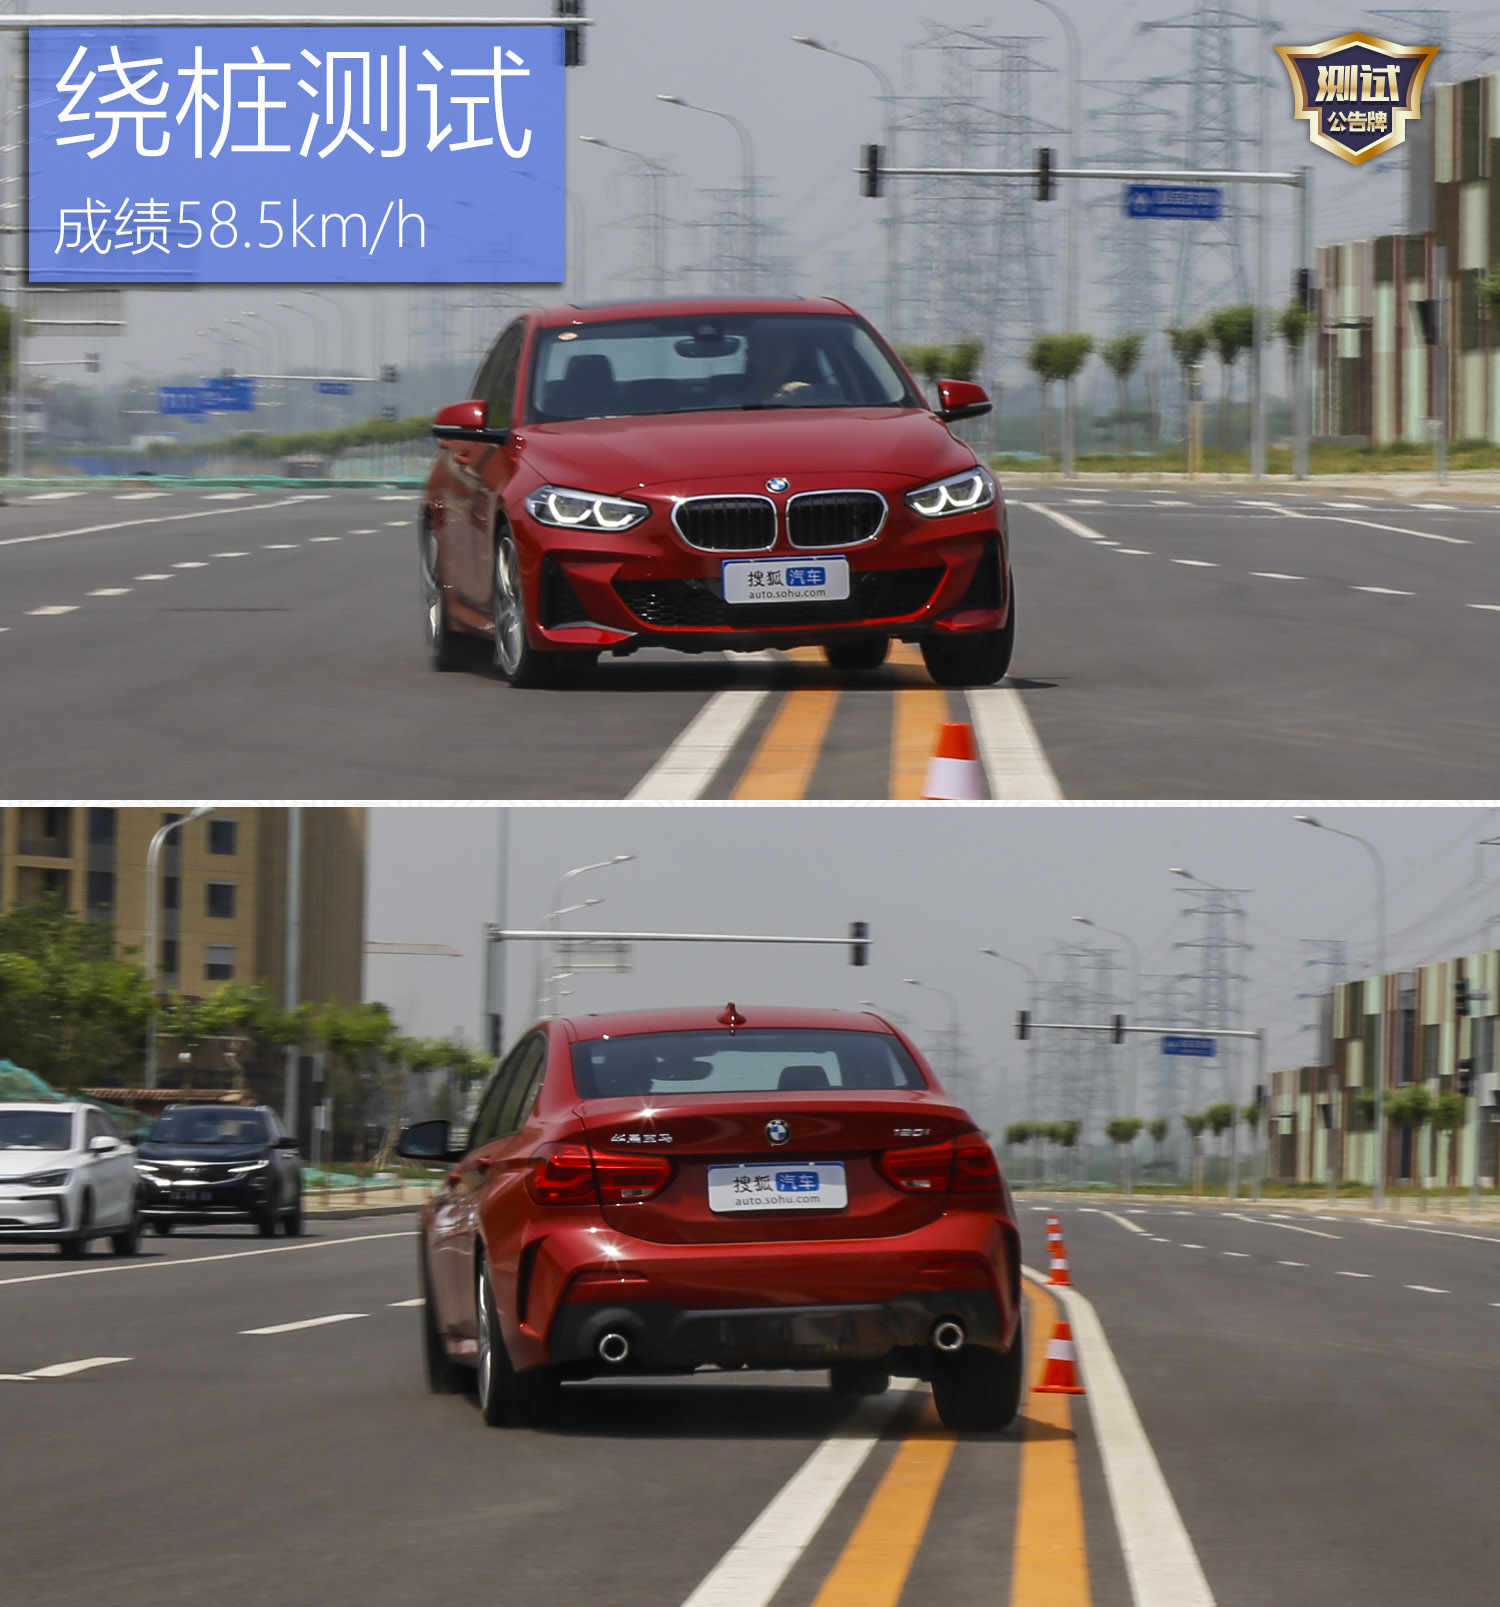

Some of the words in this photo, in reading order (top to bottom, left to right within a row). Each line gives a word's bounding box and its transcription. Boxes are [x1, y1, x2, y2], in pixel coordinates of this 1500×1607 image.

[747, 569, 823, 587] 搜狐汽车
[748, 589, 827, 600] auto.sohu.com
[733, 1174, 817, 1193] 搜狐汽车
[735, 1195, 821, 1206] auto.sohu.com
